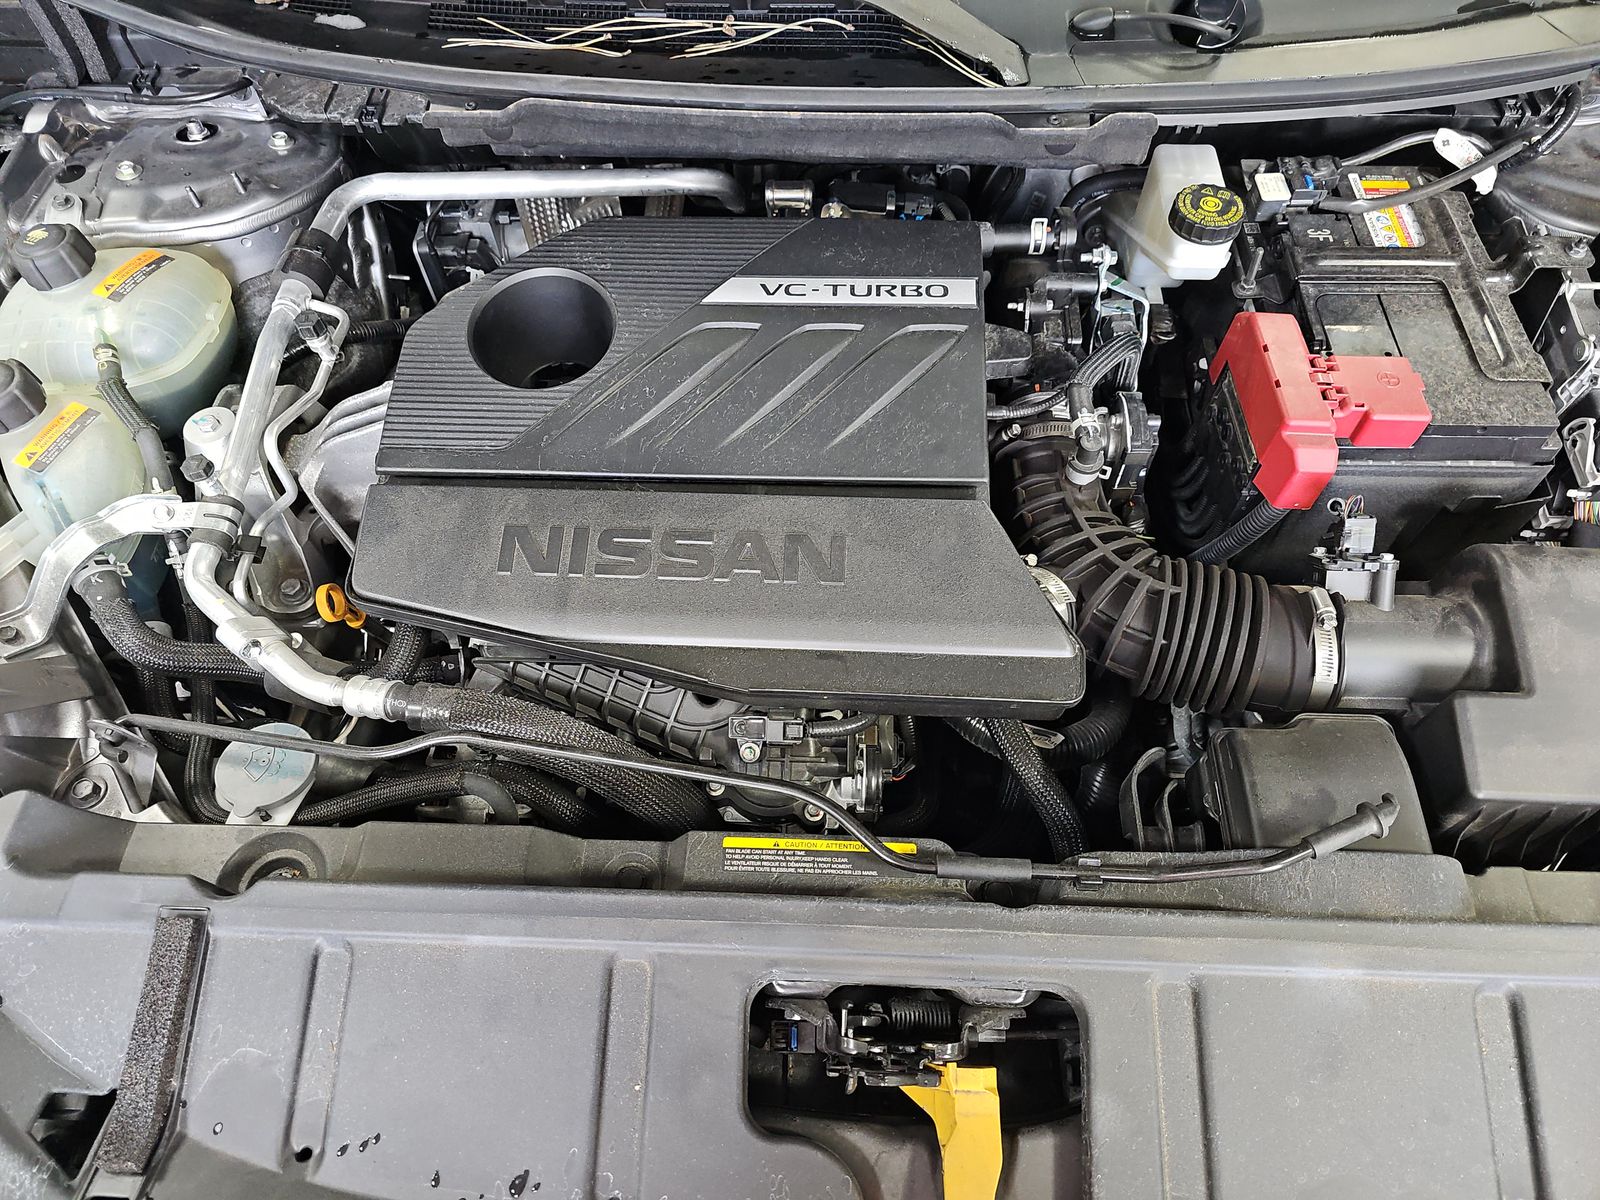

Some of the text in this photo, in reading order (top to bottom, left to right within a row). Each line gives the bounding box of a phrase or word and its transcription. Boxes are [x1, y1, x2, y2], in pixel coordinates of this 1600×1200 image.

[760, 283, 949, 298] VC-TURBO
[497, 525, 847, 585] NISSAN
[825, 842, 866, 850] ATTENTION
